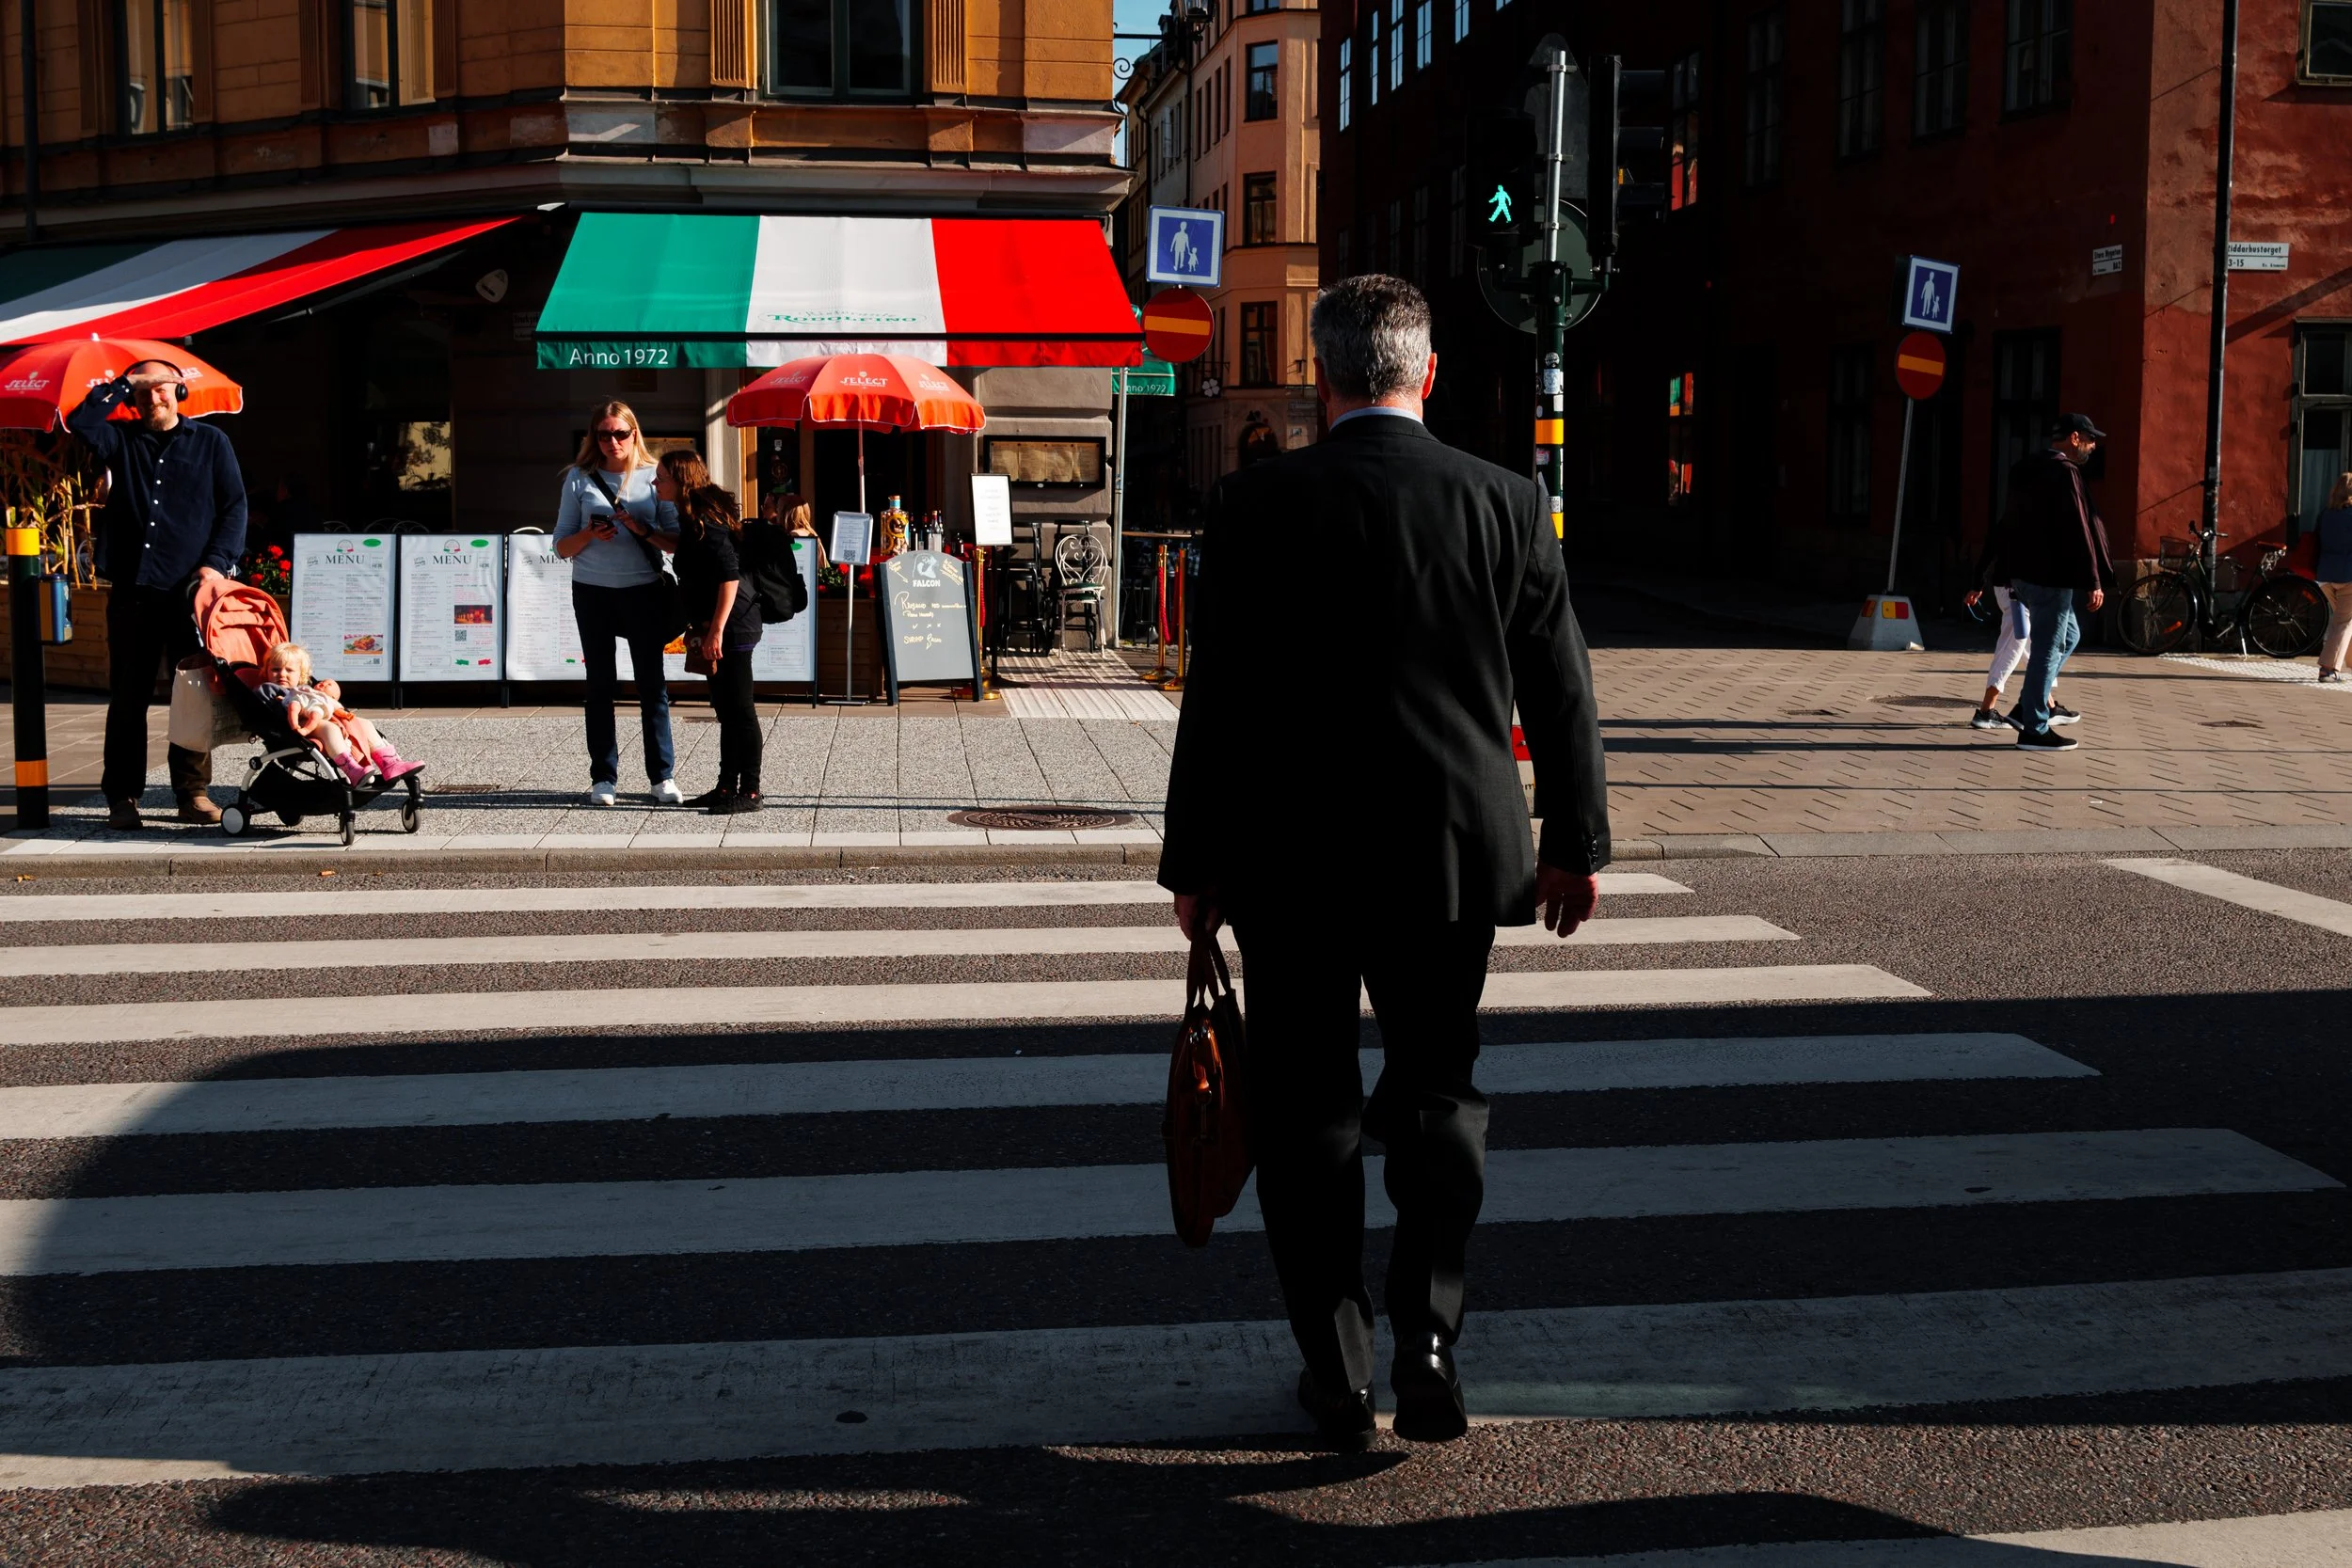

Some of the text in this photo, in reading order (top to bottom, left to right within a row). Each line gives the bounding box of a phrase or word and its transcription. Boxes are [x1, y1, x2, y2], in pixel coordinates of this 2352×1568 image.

[569, 348, 669, 365] Anno 1972
[5, 380, 50, 388] SELECT
[1147, 384, 1167, 393] 1972
[325, 555, 365, 564] MENU
[433, 555, 472, 564] MENU
[912, 579, 941, 588] FALCON
